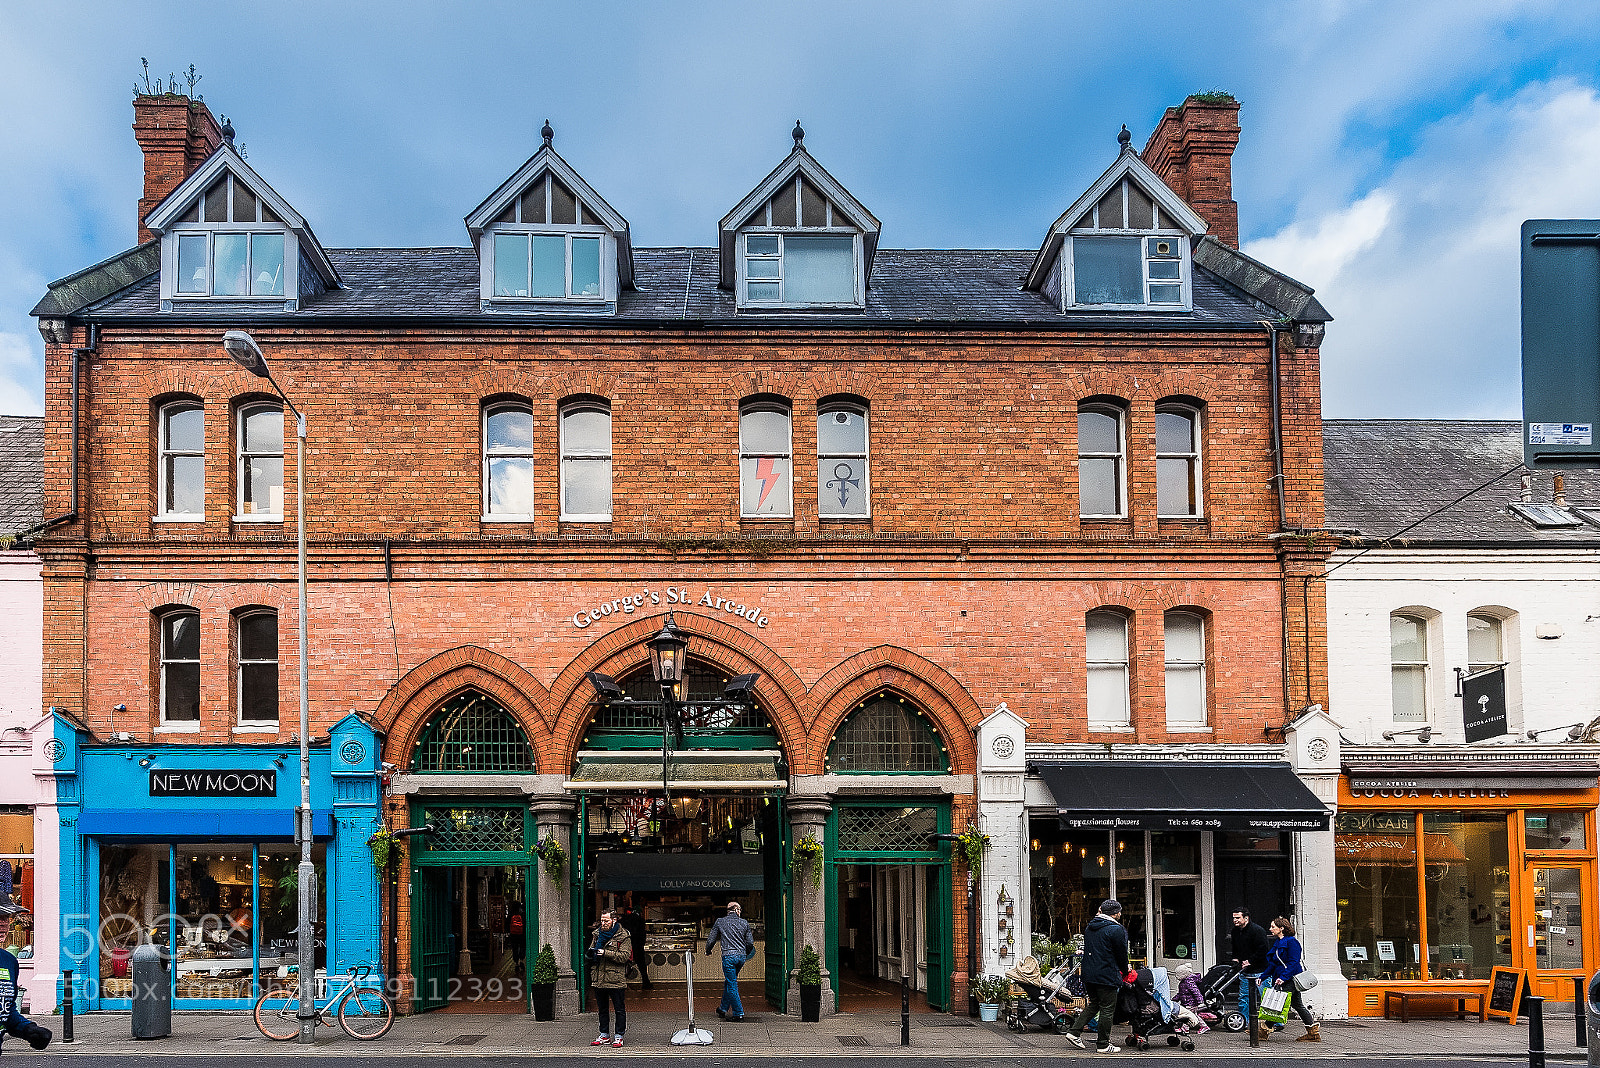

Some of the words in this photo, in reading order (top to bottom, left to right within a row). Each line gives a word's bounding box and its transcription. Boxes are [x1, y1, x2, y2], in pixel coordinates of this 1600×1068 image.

[1530, 435, 1546, 443] 2014
[572, 588, 660, 629] George's
[666, 586, 693, 605] St.
[697, 589, 769, 629] Arcade
[153, 773, 203, 791] NEW
[205, 773, 275, 792] MOON
[1069, 817, 1114, 828] appassionata
[660, 880, 686, 888] LOLLY
[701, 880, 732, 888] COOKS
[270, 939, 294, 948] NEW
